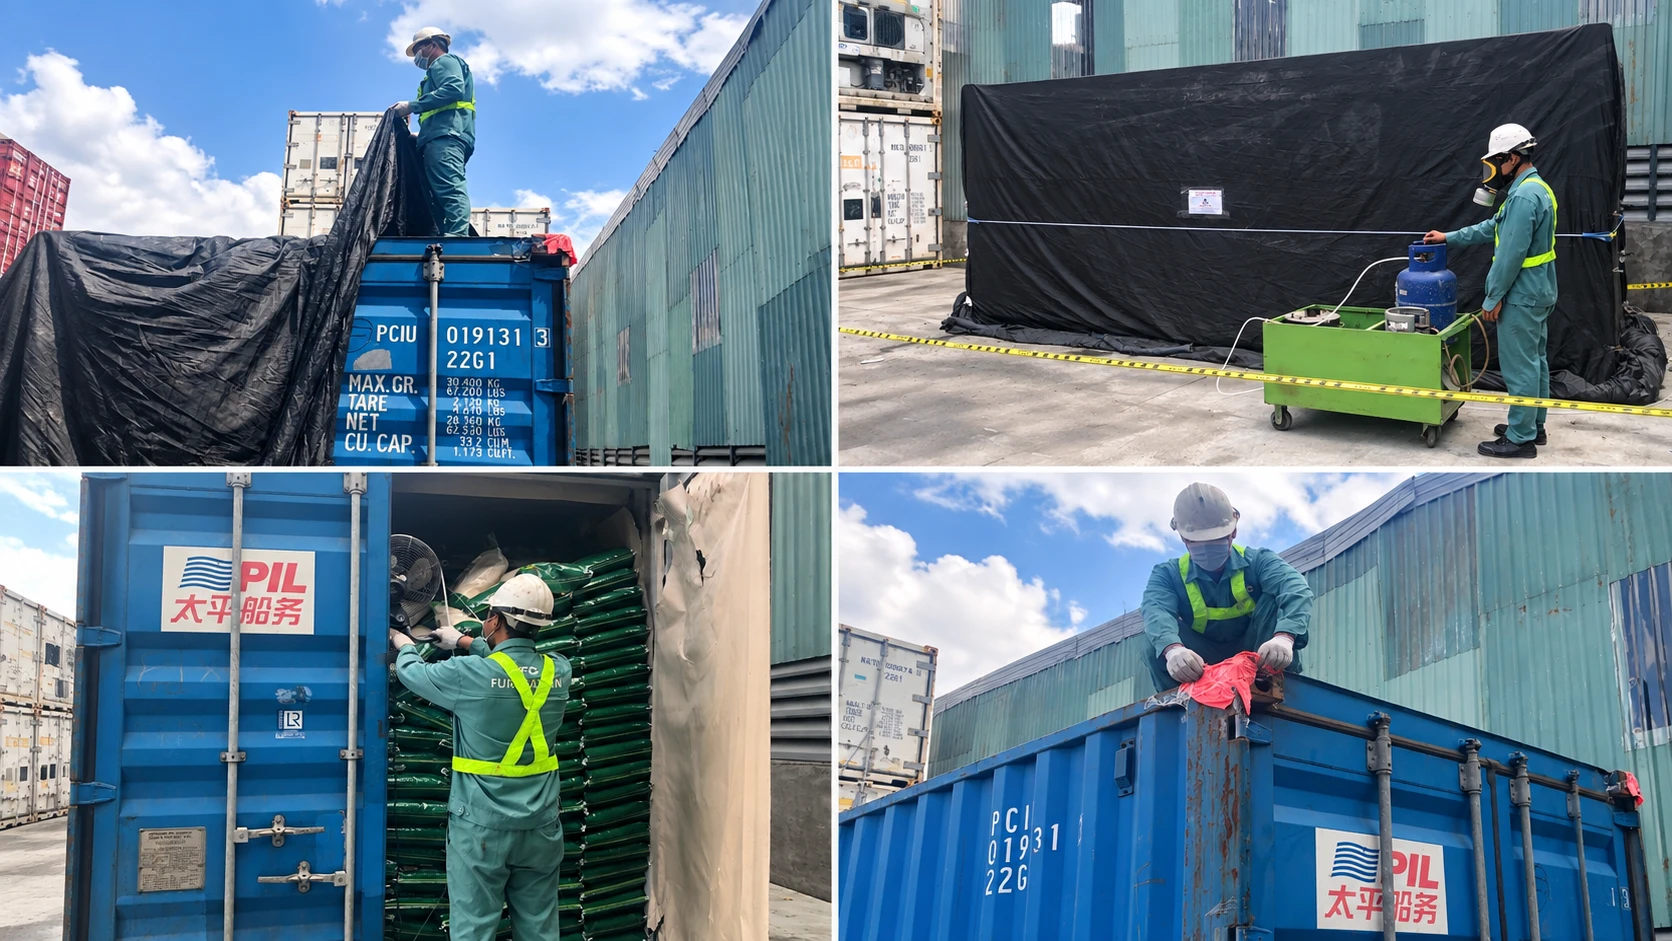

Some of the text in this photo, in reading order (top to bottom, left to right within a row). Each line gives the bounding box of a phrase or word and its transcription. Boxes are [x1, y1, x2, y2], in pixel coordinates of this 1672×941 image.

[376, 324, 549, 346] PCIU 019131 3
[446, 351, 495, 370] 22G1
[348, 394, 388, 412] TARE
[346, 413, 379, 431] NET
[240, 561, 307, 594] PIL
[170, 594, 304, 626] 太平船务
[991, 804, 1030, 836] PCI
